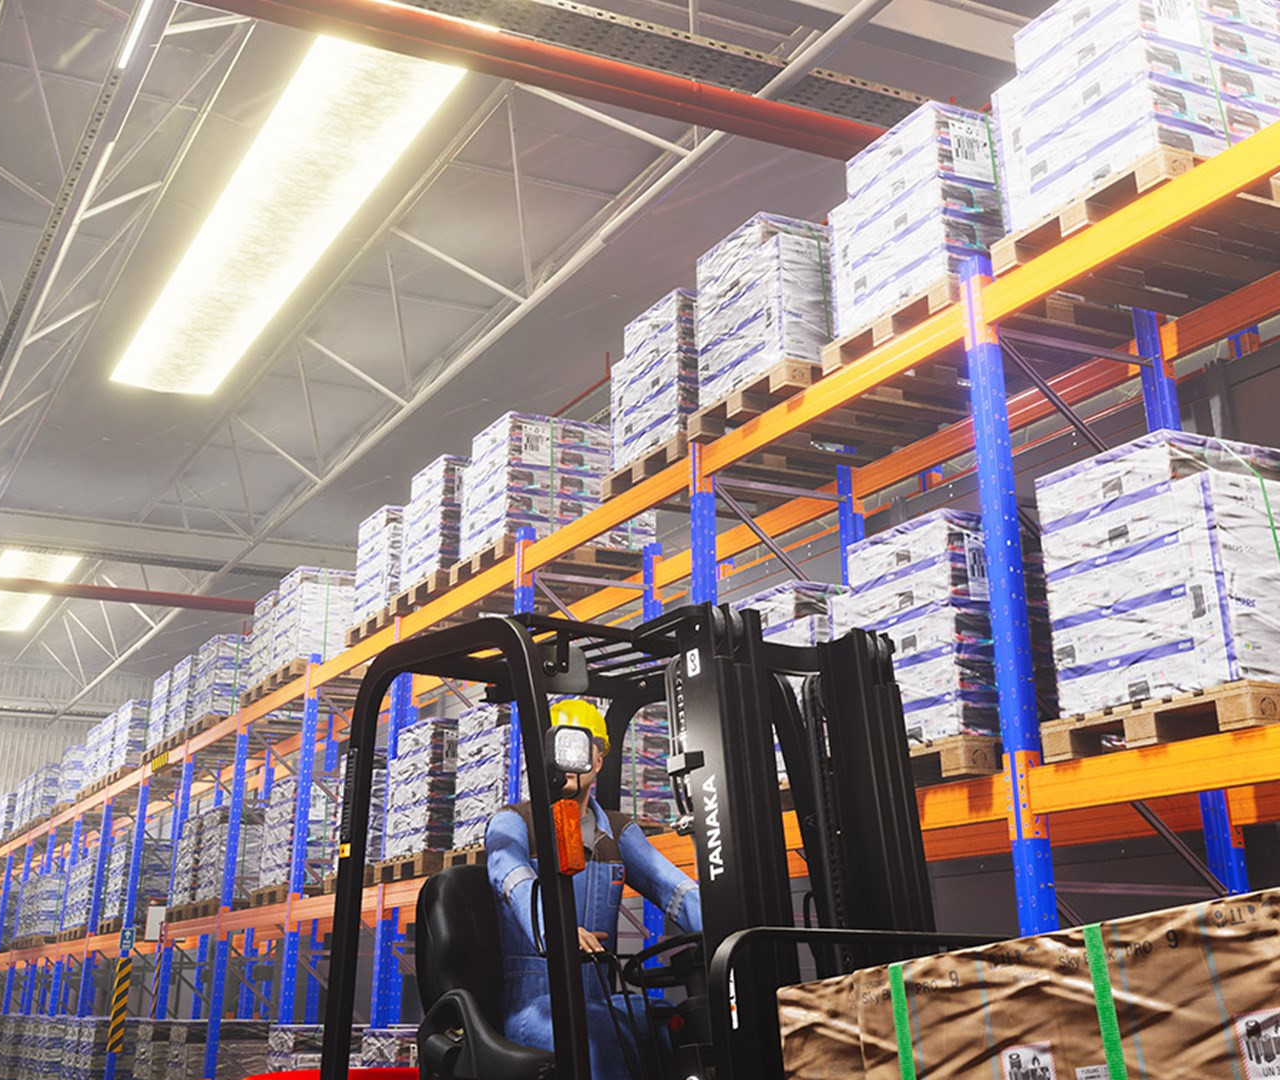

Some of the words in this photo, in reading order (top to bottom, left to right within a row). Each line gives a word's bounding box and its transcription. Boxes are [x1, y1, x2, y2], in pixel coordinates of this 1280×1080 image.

[702, 773, 725, 881] TANAKA
[1058, 952, 1081, 970] Sky
[1125, 940, 1153, 959] PRO
[1165, 929, 1179, 949] 9
[915, 979, 938, 995] PRO
[948, 970, 960, 987] 9
[1262, 1065, 1276, 1078] UN
